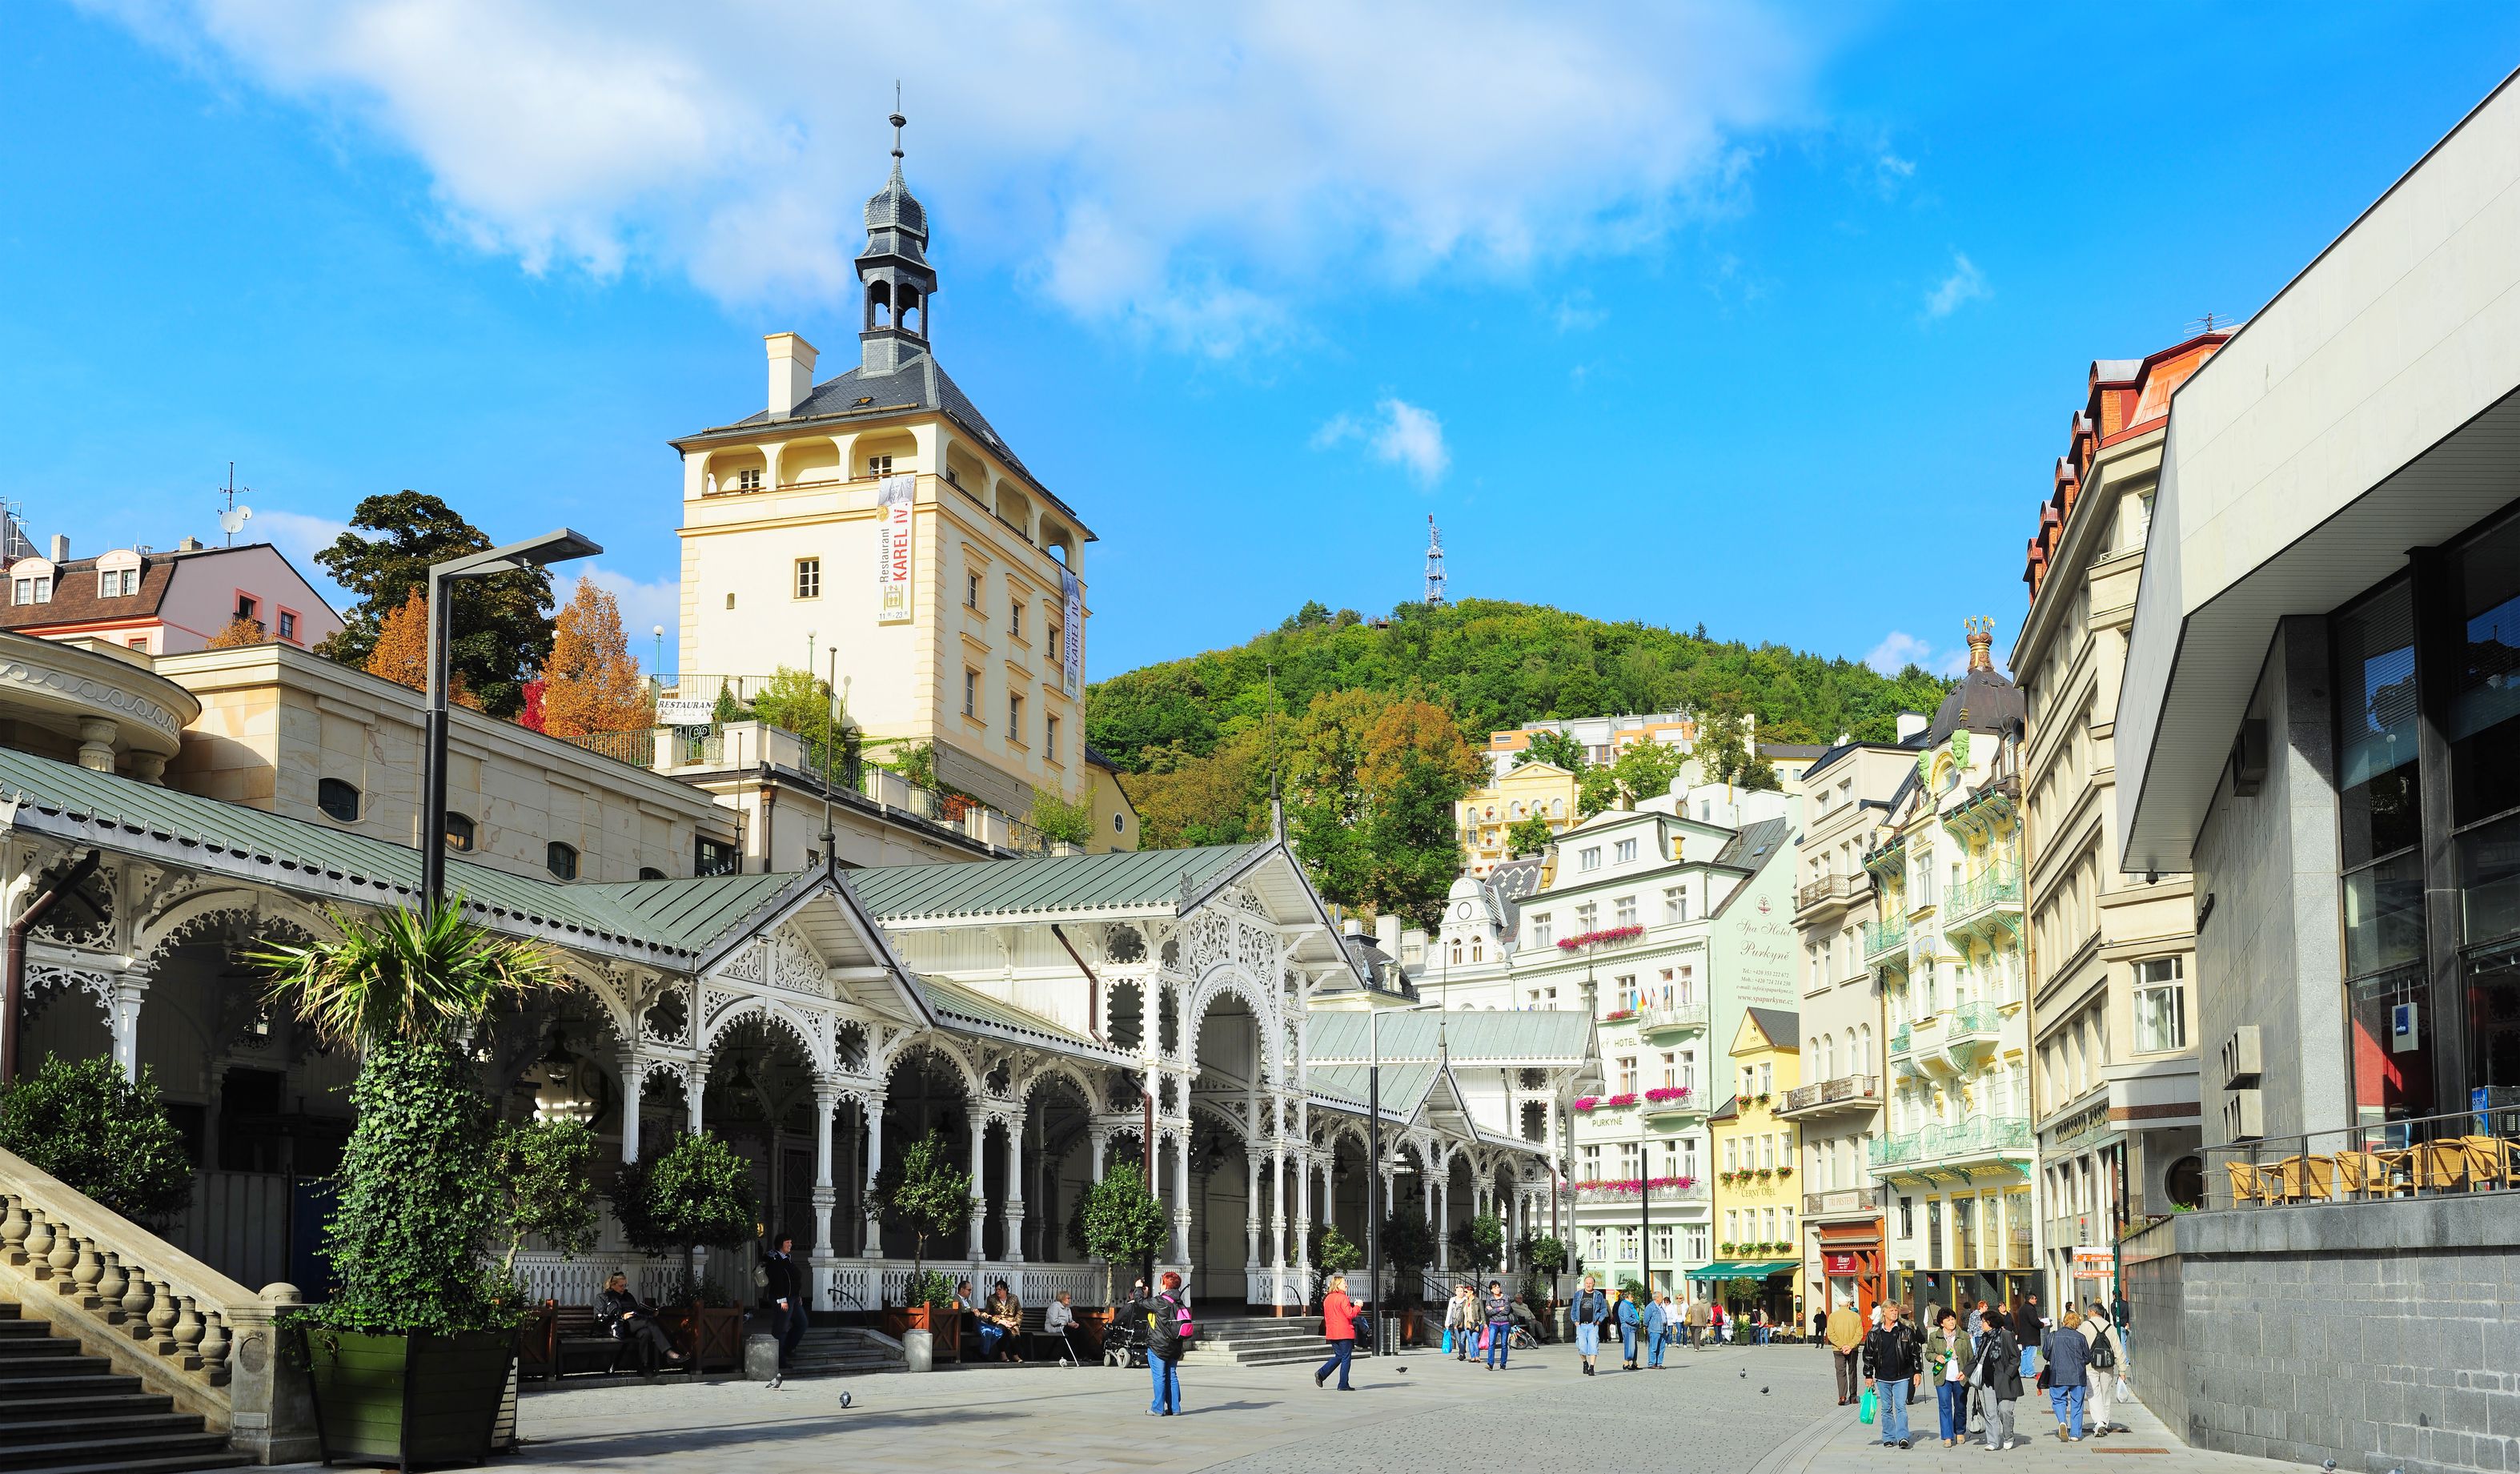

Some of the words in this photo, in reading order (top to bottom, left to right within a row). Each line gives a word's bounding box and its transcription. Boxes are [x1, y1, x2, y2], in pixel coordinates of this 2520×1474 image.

[879, 528, 889, 583] Restaurant
[893, 528, 908, 581] KAREL
[1071, 623, 1079, 667] KAREL
[658, 701, 717, 709] RESTAURANT
[1736, 918, 1757, 935] Spa
[1761, 922, 1792, 936] Hotel
[1740, 940, 1791, 965] Purkyně
[1737, 995, 1793, 1005] www.spapurkyne.cz
[1614, 1037, 1637, 1047] HOTEL
[1592, 1116, 1623, 1127] PURKYNĚ
